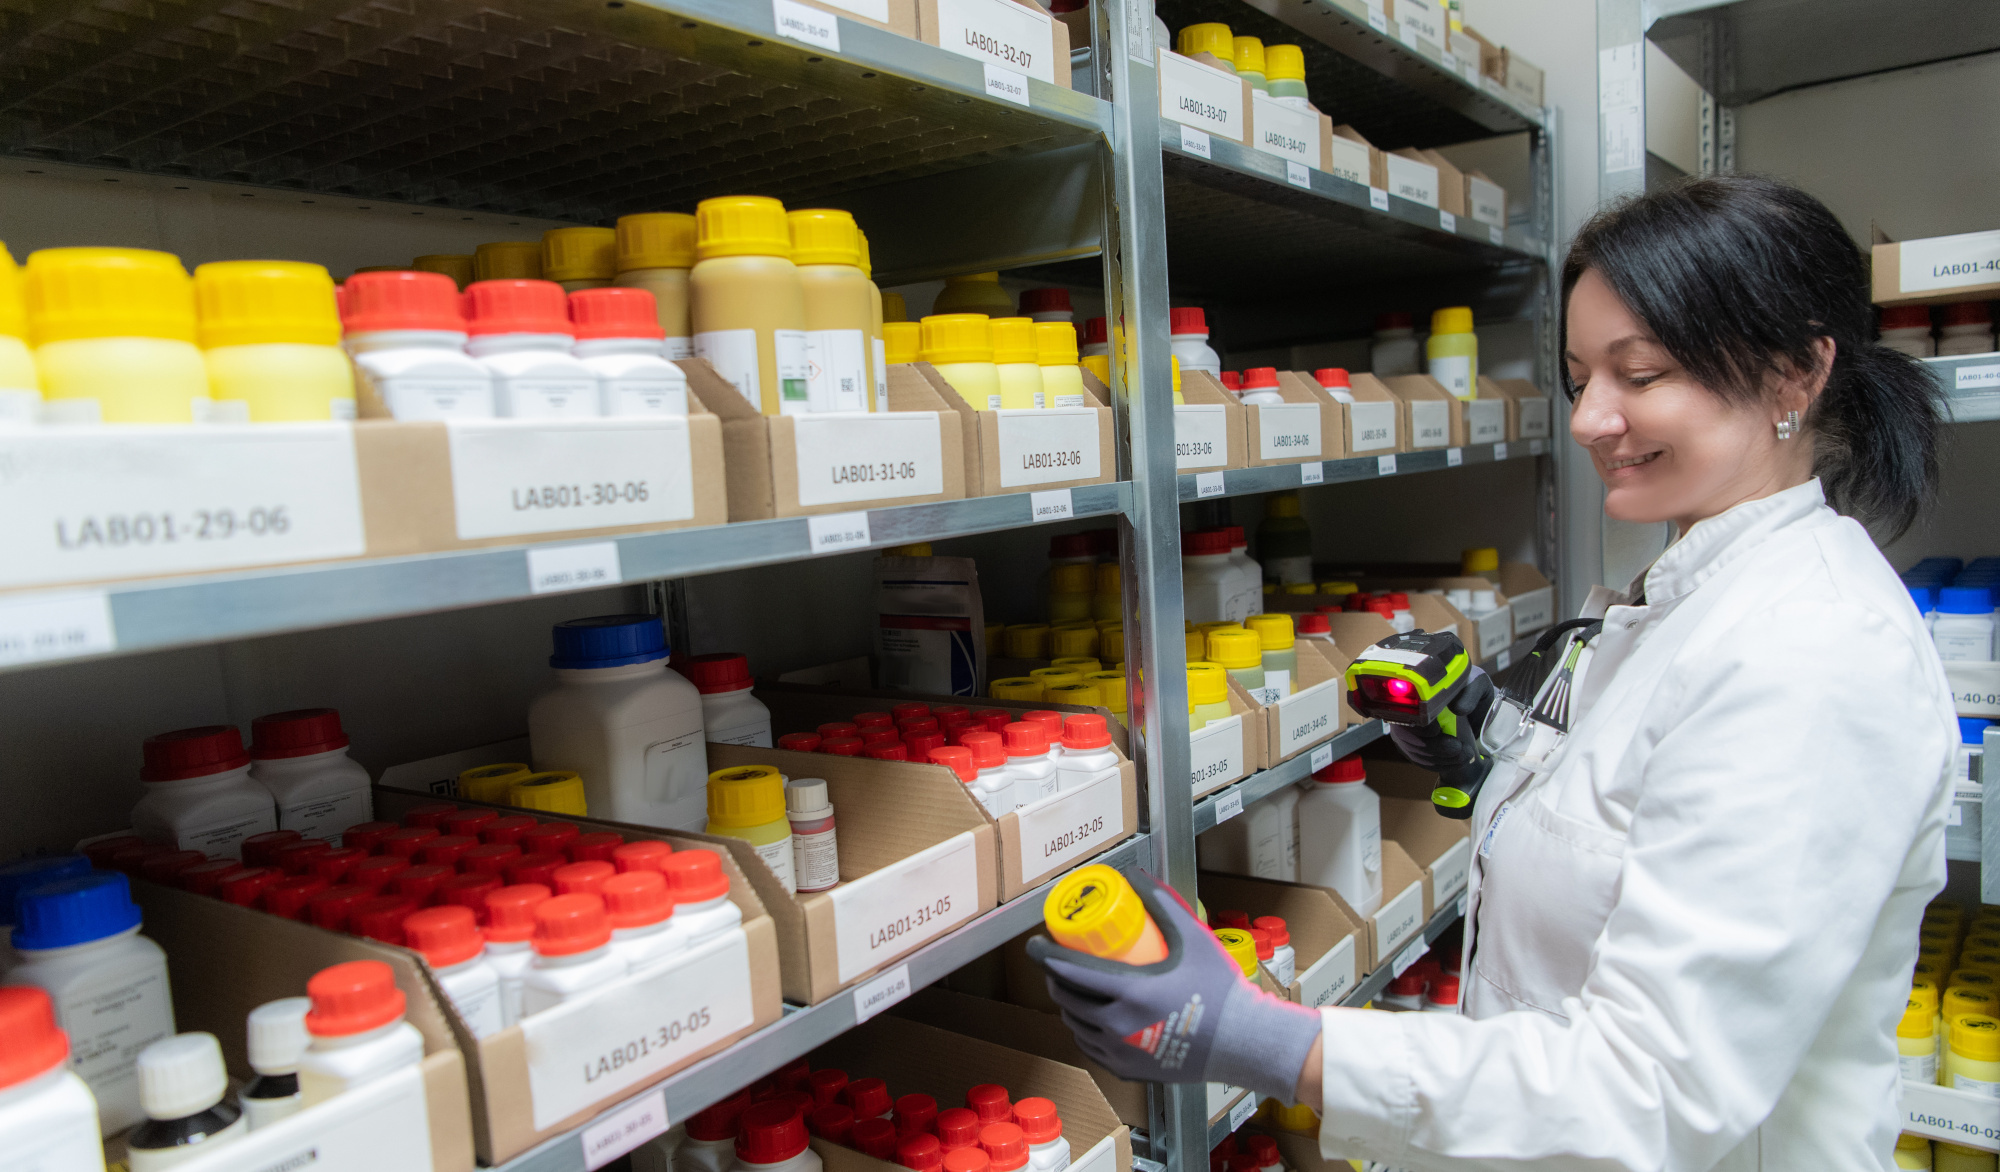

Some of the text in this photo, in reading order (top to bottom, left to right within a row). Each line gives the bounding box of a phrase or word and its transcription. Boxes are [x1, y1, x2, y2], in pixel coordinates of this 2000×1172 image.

[965, 28, 1032, 69] LAB01-32-07
[987, 77, 1022, 96] LAB01-32-07
[1179, 95, 1228, 123] LAB01-33-07
[1183, 138, 1207, 153] LAB01-33-07
[1265, 131, 1307, 154] LAB01-34-07
[1273, 434, 1310, 448] LAB01-34-06
[831, 461, 916, 485] LAB01-31-06
[1022, 450, 1082, 471] LAB01-32-06
[511, 480, 650, 511] LAB01-30-06
[1200, 485, 1223, 495] LAB01-33-06
[1036, 505, 1068, 516] LAB01-32-06
[54, 505, 292, 551] LAB01-29-06
[1292, 714, 1328, 741] LAB01-34-05
[1044, 816, 1103, 858] LAB01-32-05
[870, 896, 951, 950] LAB01-31-05
[1313, 974, 1345, 1010] LAB01-34-04
[584, 1006, 711, 1084] LAB01-30-05
